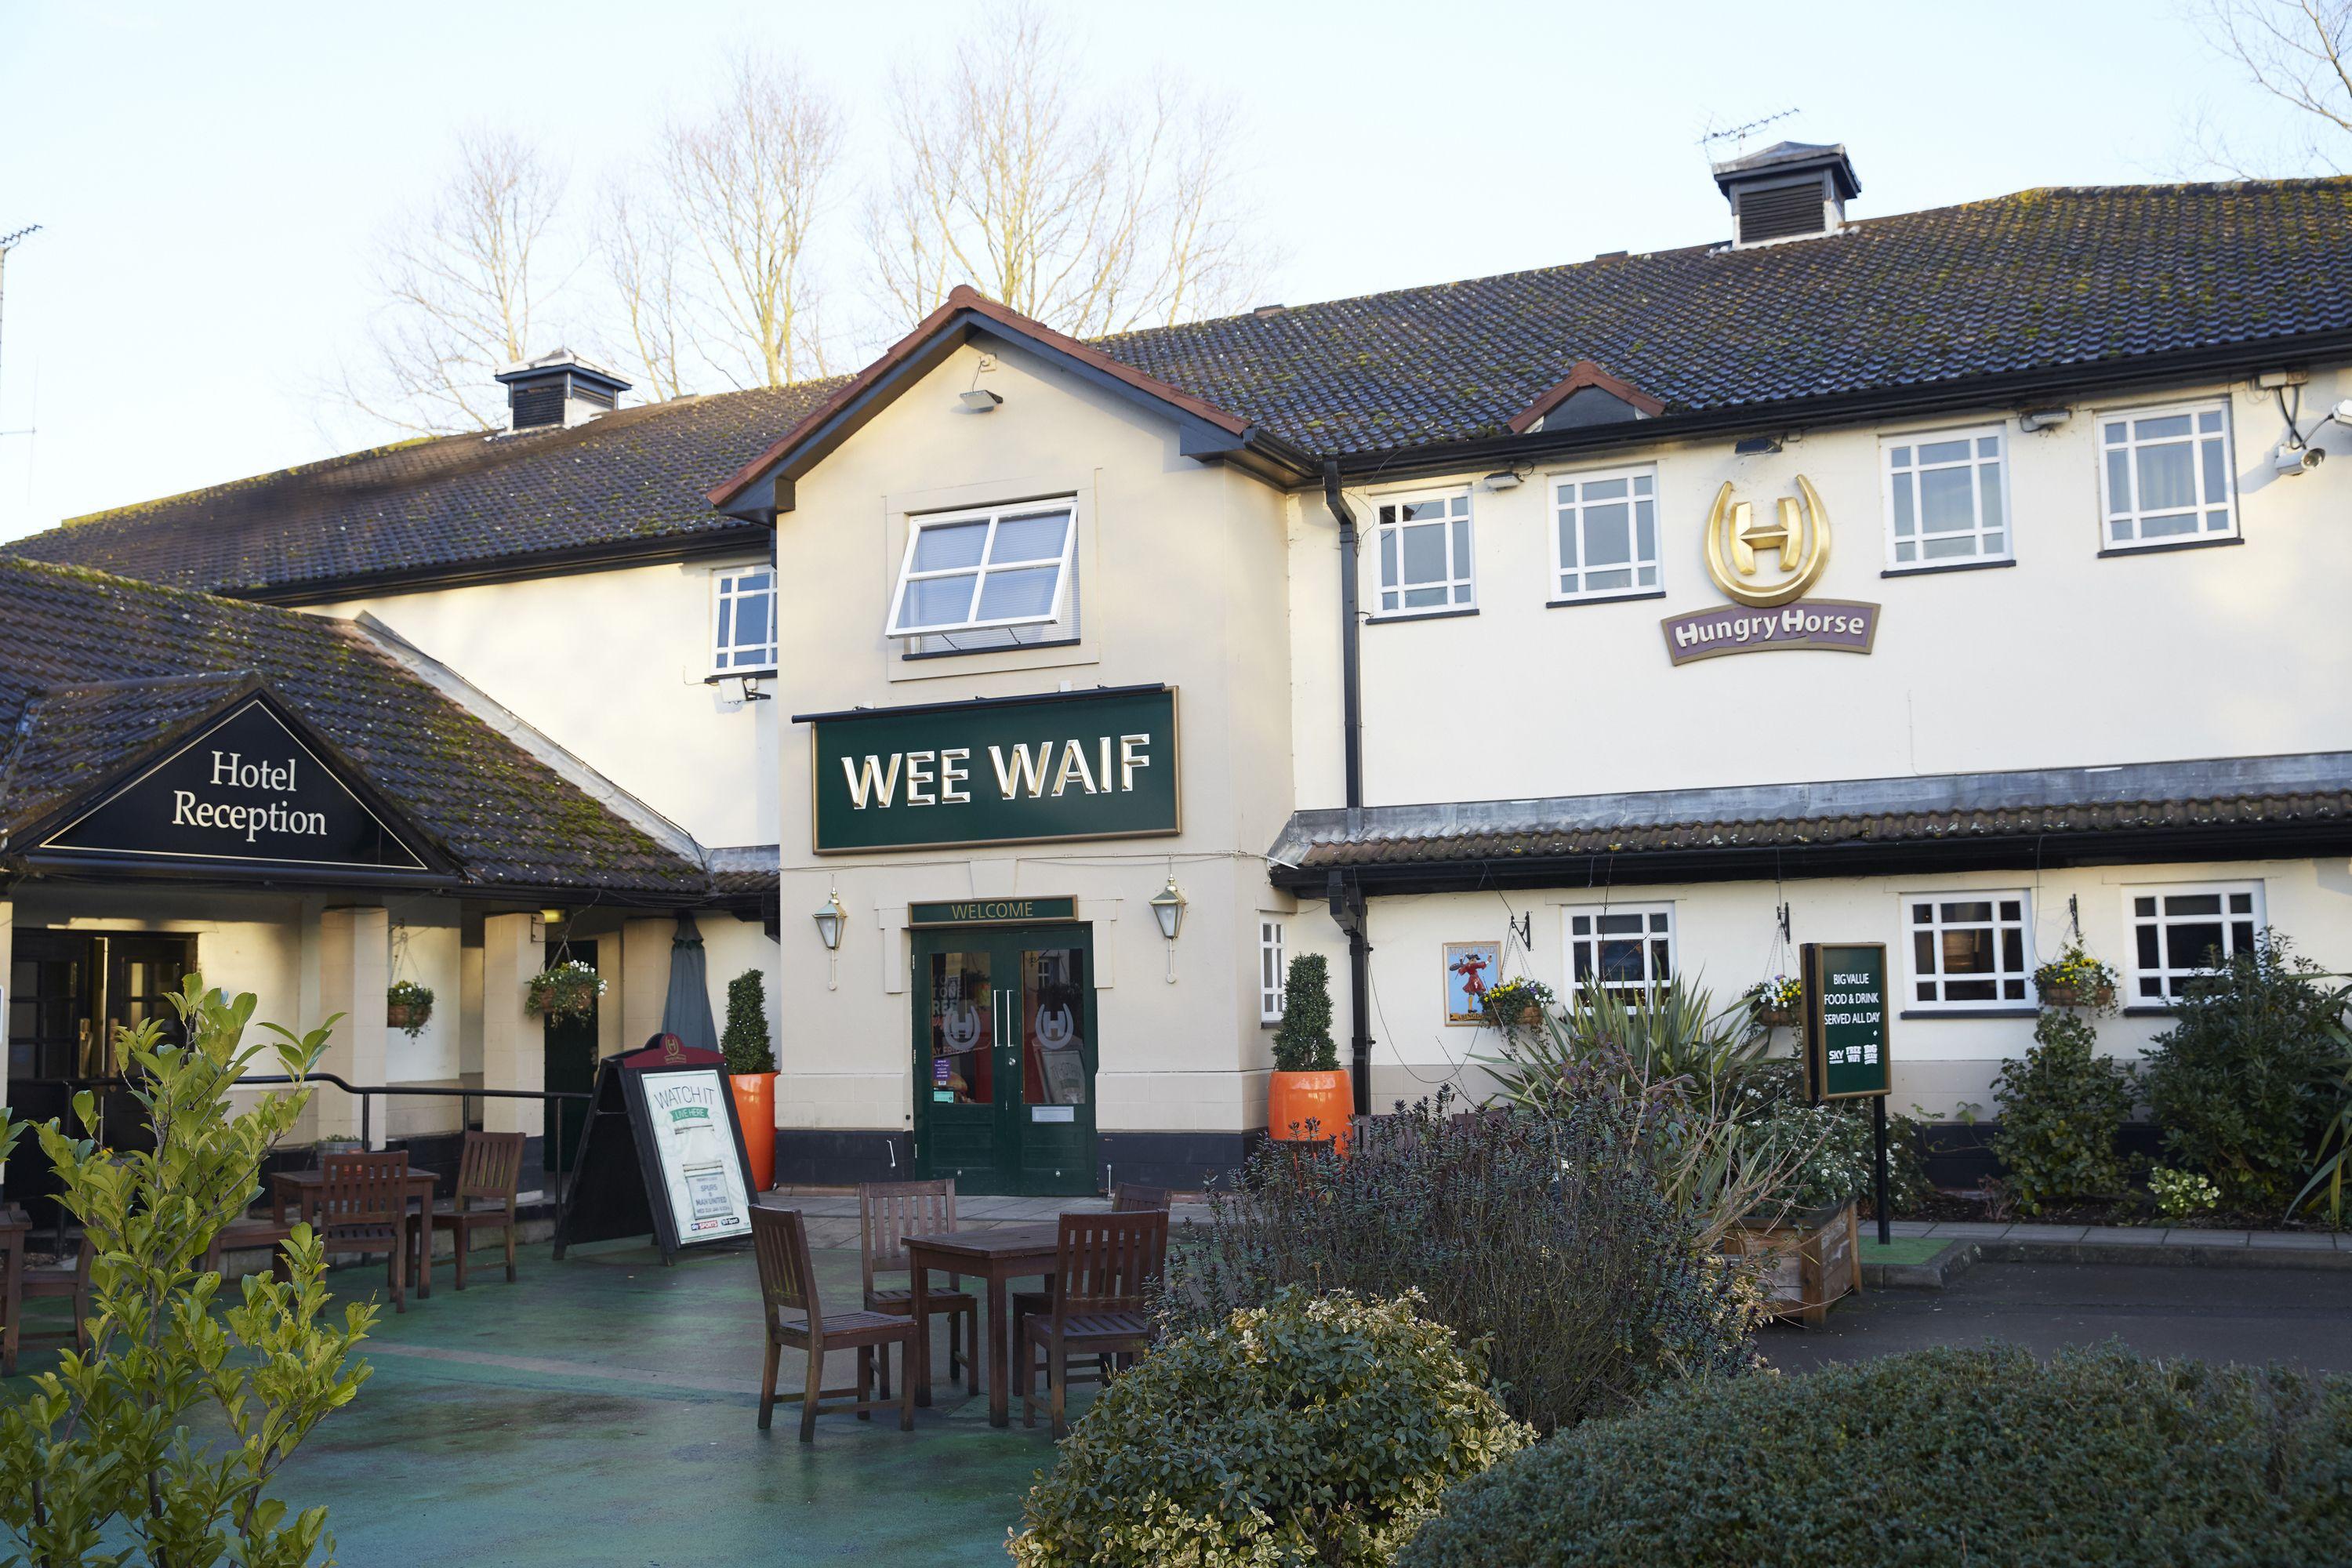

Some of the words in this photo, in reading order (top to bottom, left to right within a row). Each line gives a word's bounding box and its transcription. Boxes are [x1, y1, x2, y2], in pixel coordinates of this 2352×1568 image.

[210, 750, 296, 792] Hotel
[840, 748, 971, 810] WEE
[988, 733, 1151, 800] WAIF
[172, 789, 328, 842] Reception
[952, 902, 1033, 920] WELCOME
[1833, 974, 1846, 985] BIG
[1846, 973, 1870, 984] VALUE
[1824, 993, 1847, 1005] FOOD
[1849, 993, 1854, 1004] &
[1856, 993, 1879, 1004] DRINK
[1824, 1013, 1851, 1025] SERVED
[1852, 1013, 1865, 1023] ALL
[1867, 1012, 1881, 1023] DAY
[1829, 1050, 1844, 1060] SKY
[654, 1087, 702, 1109] WATCH
[703, 1087, 714, 1105] IT
[675, 1109, 688, 1119] LIVE
[689, 1109, 704, 1117] HERE
[699, 1220, 718, 1229] SPORTS
